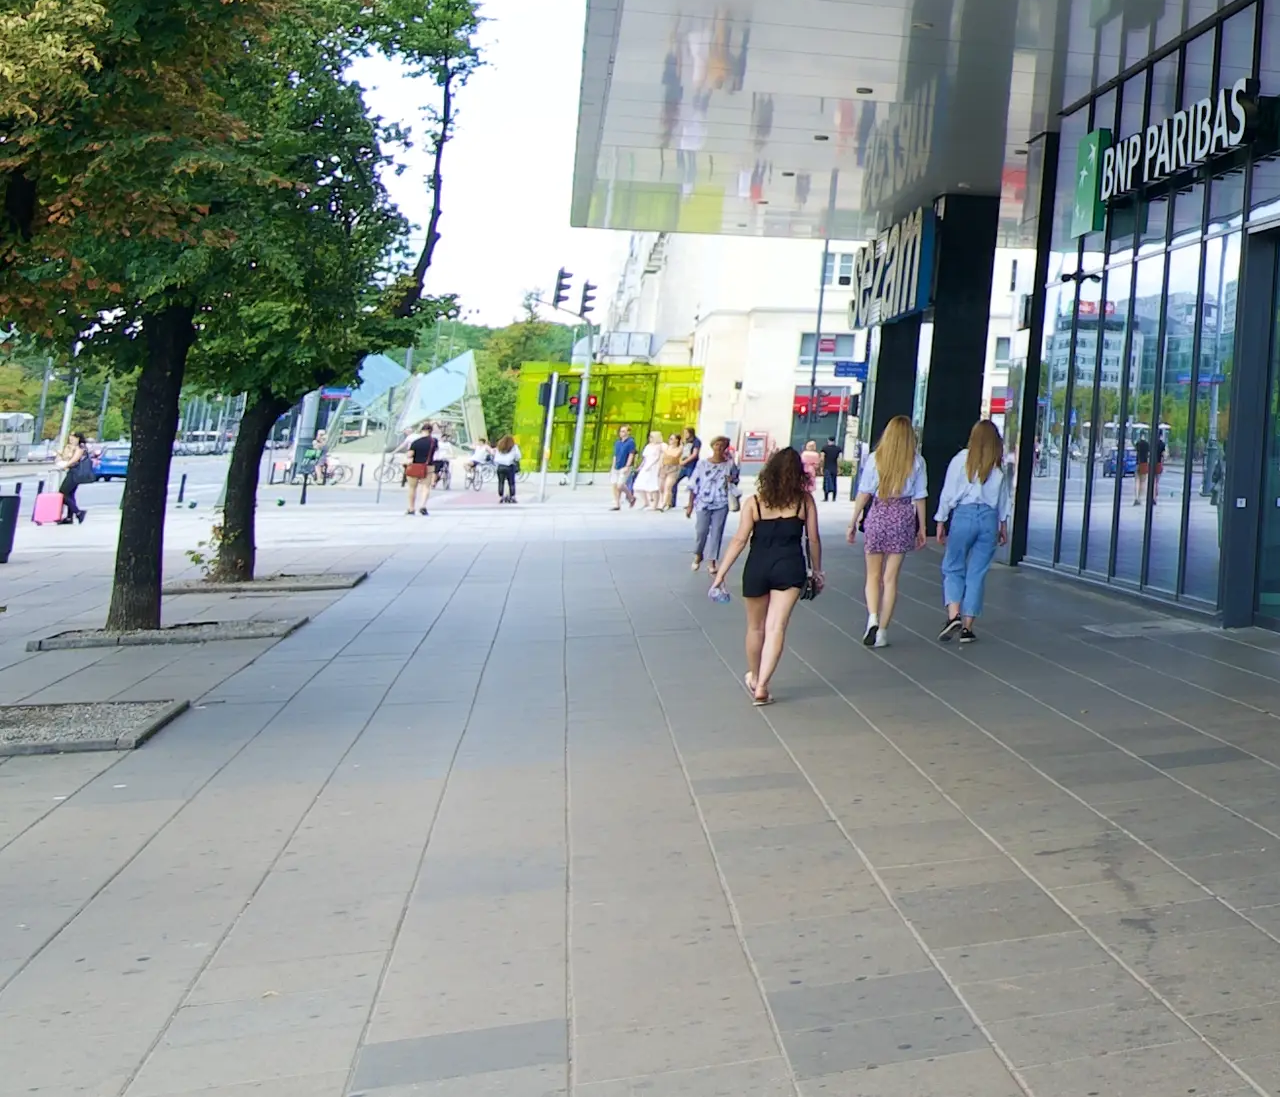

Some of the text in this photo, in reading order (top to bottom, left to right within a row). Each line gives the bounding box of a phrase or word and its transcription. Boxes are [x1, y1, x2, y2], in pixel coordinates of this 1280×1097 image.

[1101, 77, 1248, 201] BNP PARIBAS
[848, 206, 922, 330] sezam
